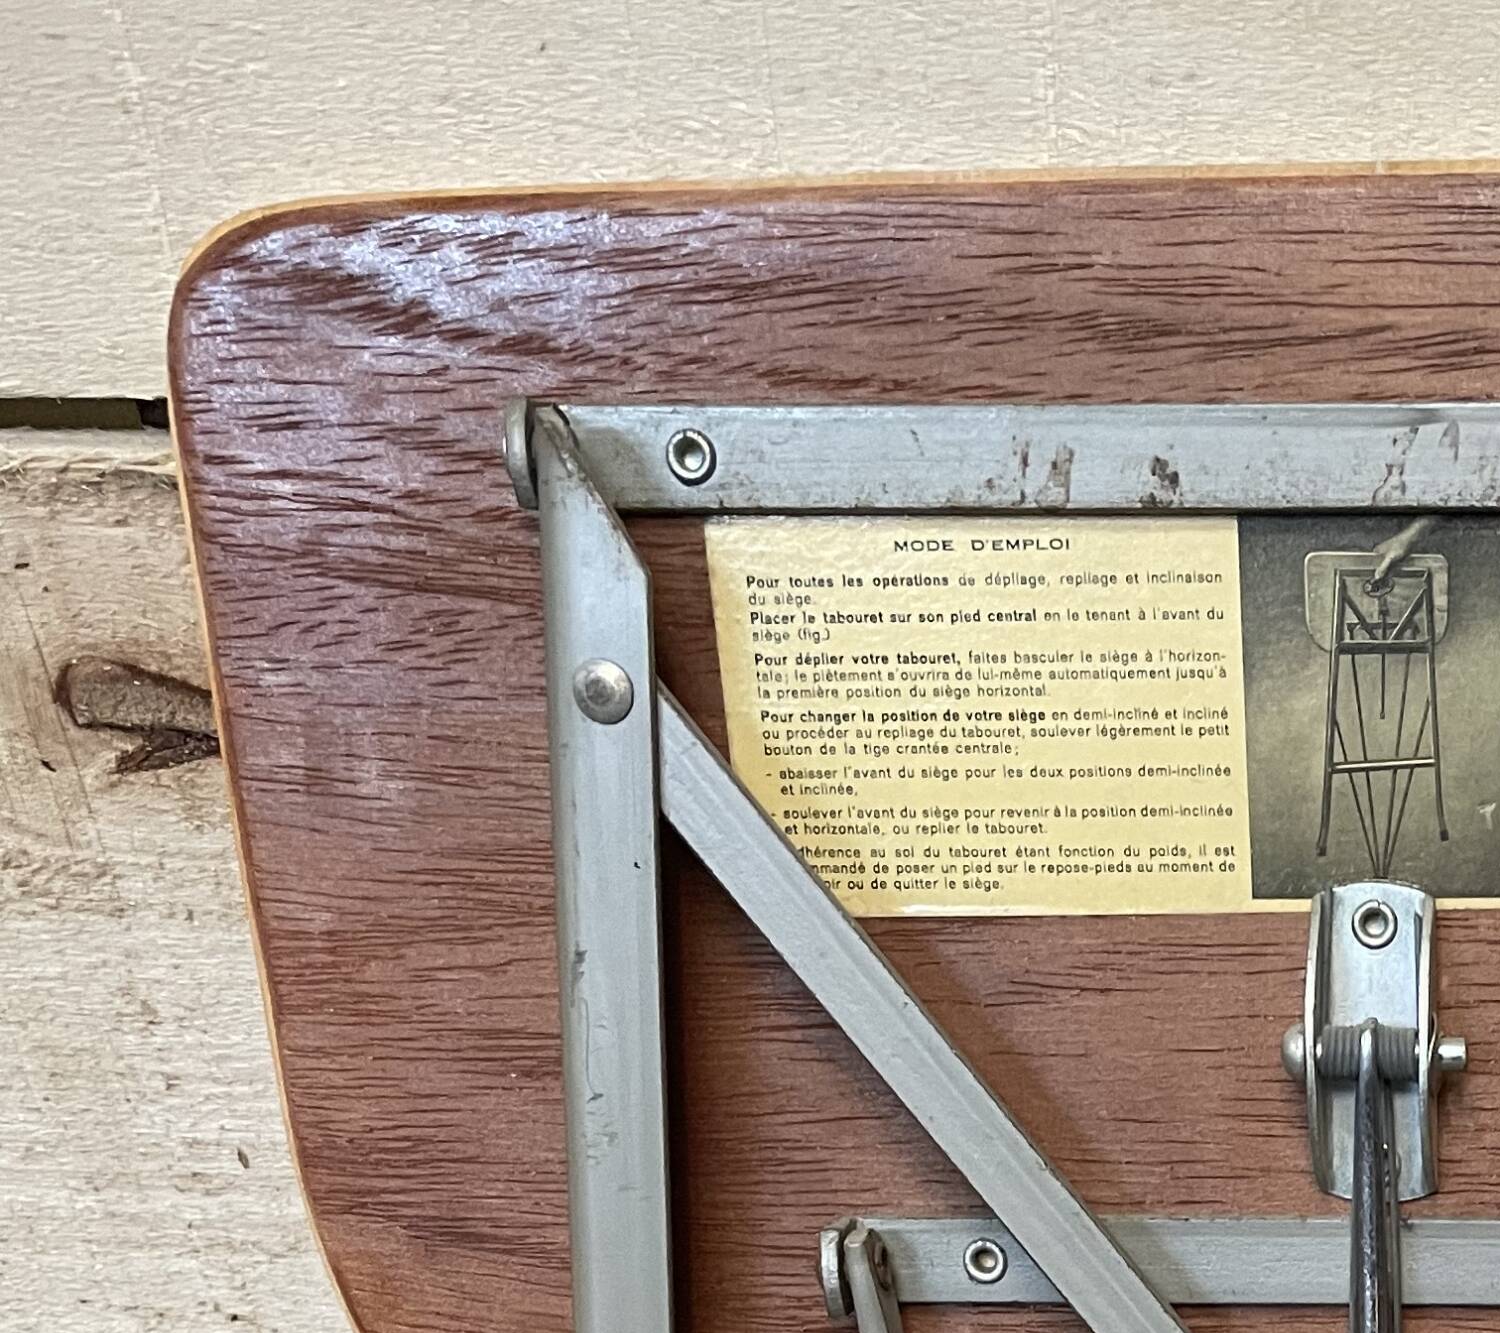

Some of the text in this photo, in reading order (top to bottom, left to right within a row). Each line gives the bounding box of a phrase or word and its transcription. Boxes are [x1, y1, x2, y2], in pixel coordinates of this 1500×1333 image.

[894, 538, 1069, 552] MODE D'EMPLOI
[746, 575, 780, 587] Pour
[789, 574, 834, 587] toutes
[842, 574, 863, 586] les
[872, 573, 949, 590] opérations
[958, 573, 975, 585] de
[1060, 571, 1117, 588] repliage
[1126, 571, 1139, 583] et
[1147, 570, 1222, 583] inclinaison
[748, 593, 766, 605] du
[750, 607, 1223, 625] Placer le tabouret sur son pied central en le tenant à l'avant du
[752, 629, 790, 644] siège
[755, 652, 788, 665] Pour
[795, 652, 844, 668] déplier
[852, 652, 889, 664] votre
[969, 651, 1006, 663] faites
[1014, 650, 1074, 663] basculer
[1080, 650, 1092, 662] le
[1100, 650, 1137, 666] siège
[1145, 649, 1153, 662] à
[757, 686, 770, 698] la
[777, 685, 839, 701] première
[846, 685, 901, 701] position
[909, 685, 926, 697] du
[933, 684, 970, 700] siège
[761, 710, 794, 722] Pour
[800, 709, 856, 725] changer
[862, 709, 874, 721] la
[882, 709, 938, 725] position
[943, 708, 960, 721] de
[965, 708, 1002, 721] votre
[1008, 708, 1045, 724] siège
[1052, 711, 1068, 720] en
[1165, 707, 1178, 719] et
[1183, 707, 1228, 719] incliné
[762, 730, 780, 738] ou
[786, 726, 850, 742] procéder
[856, 729, 872, 738] au
[878, 725, 934, 741] repliage
[939, 725, 957, 737] du
[1031, 724, 1091, 737] soulever
[1096, 723, 1176, 740] légèrement
[1181, 723, 1193, 735] le
[1199, 723, 1229, 739] petit
[764, 742, 812, 754] bouton
[819, 742, 836, 754] de
[844, 742, 856, 754] la
[864, 742, 889, 757] tige
[896, 742, 949, 754] crantée
[779, 766, 838, 779] abaisser
[844, 766, 892, 778] l'avant
[898, 766, 915, 778] du
[921, 765, 958, 781] siège
[965, 768, 996, 781] pour
[1003, 765, 1023, 777] les
[1030, 765, 1064, 777] deux
[1069, 764, 1132, 780] positions
[780, 782, 795, 794] et
[870, 848, 885, 857] au
[895, 845, 914, 857] sol
[923, 845, 940, 857] du
[949, 845, 1007, 857] tabouret
[1015, 845, 1050, 857] étant
[1058, 844, 1114, 857] fonction
[1124, 844, 1140, 856] du
[1199, 844, 1207, 856] il
[1215, 844, 1236, 856] est
